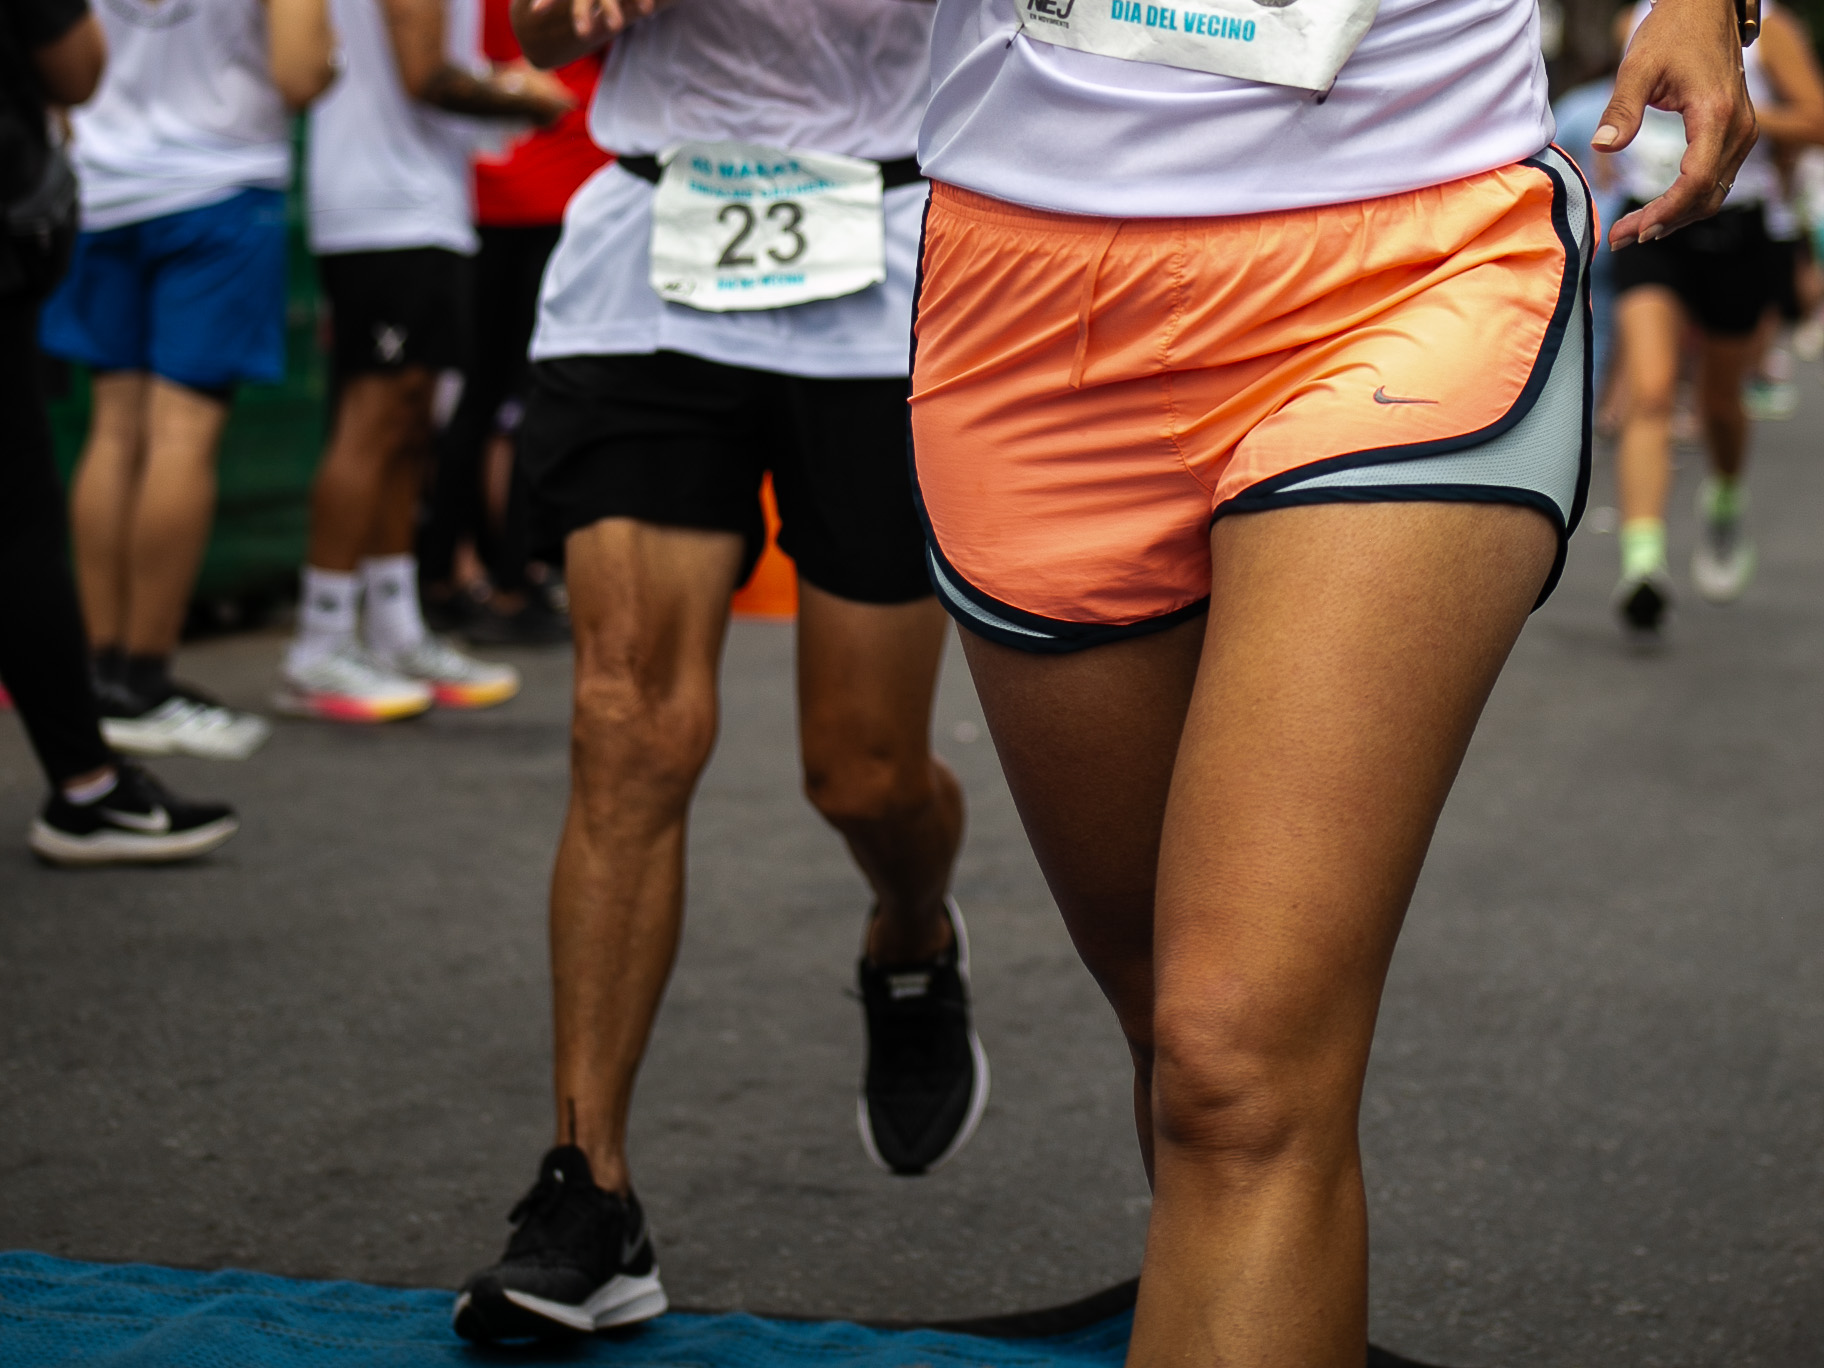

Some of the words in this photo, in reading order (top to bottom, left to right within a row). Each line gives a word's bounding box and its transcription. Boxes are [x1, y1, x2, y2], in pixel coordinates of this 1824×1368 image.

[1111, 0, 1143, 26] DIA
[1146, 5, 1178, 32] DEL
[1184, 12, 1256, 42] VECINO
[717, 201, 807, 267] 23
